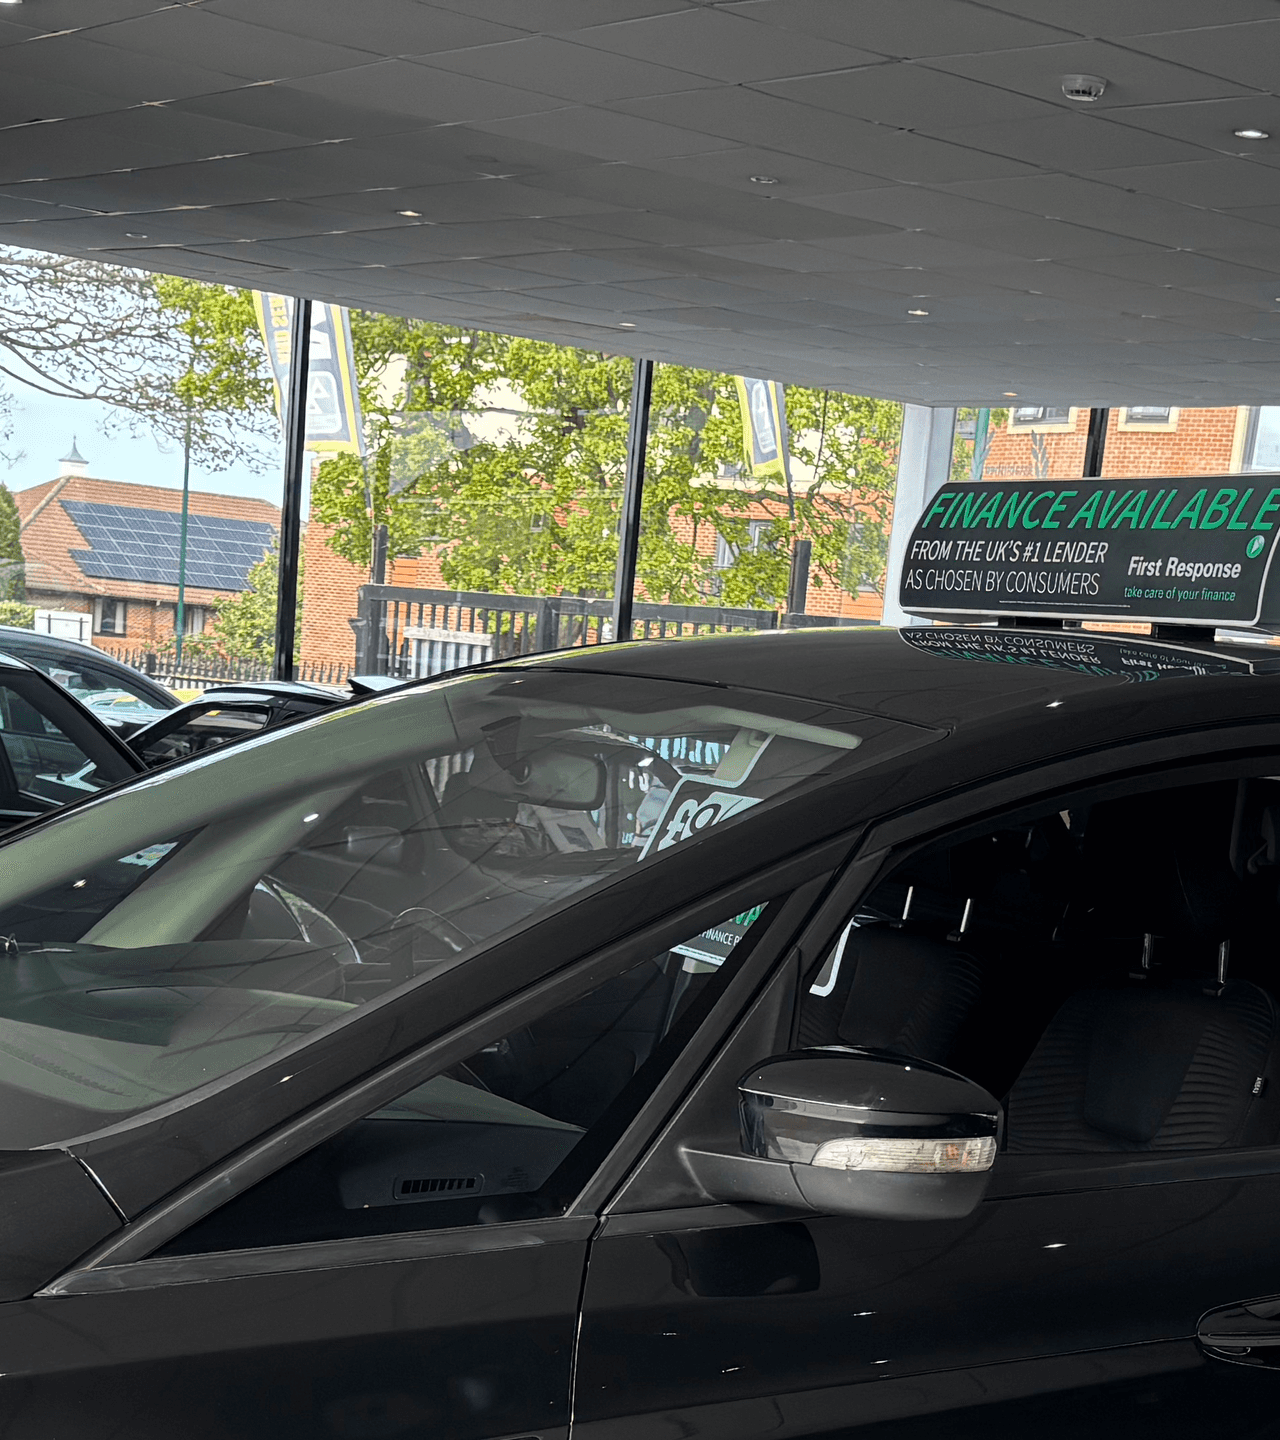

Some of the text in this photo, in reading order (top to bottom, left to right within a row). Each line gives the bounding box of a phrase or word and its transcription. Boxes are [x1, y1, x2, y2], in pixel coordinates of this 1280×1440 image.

[921, 490, 1079, 530] FINANCE
[910, 540, 1109, 563] FROM THE UK'S #1 LENDER
[905, 569, 1101, 595] AS CHOSEN BY CONSUMERS
[1127, 556, 1242, 582] First Response
[1124, 586, 1236, 602] take care of your finance
